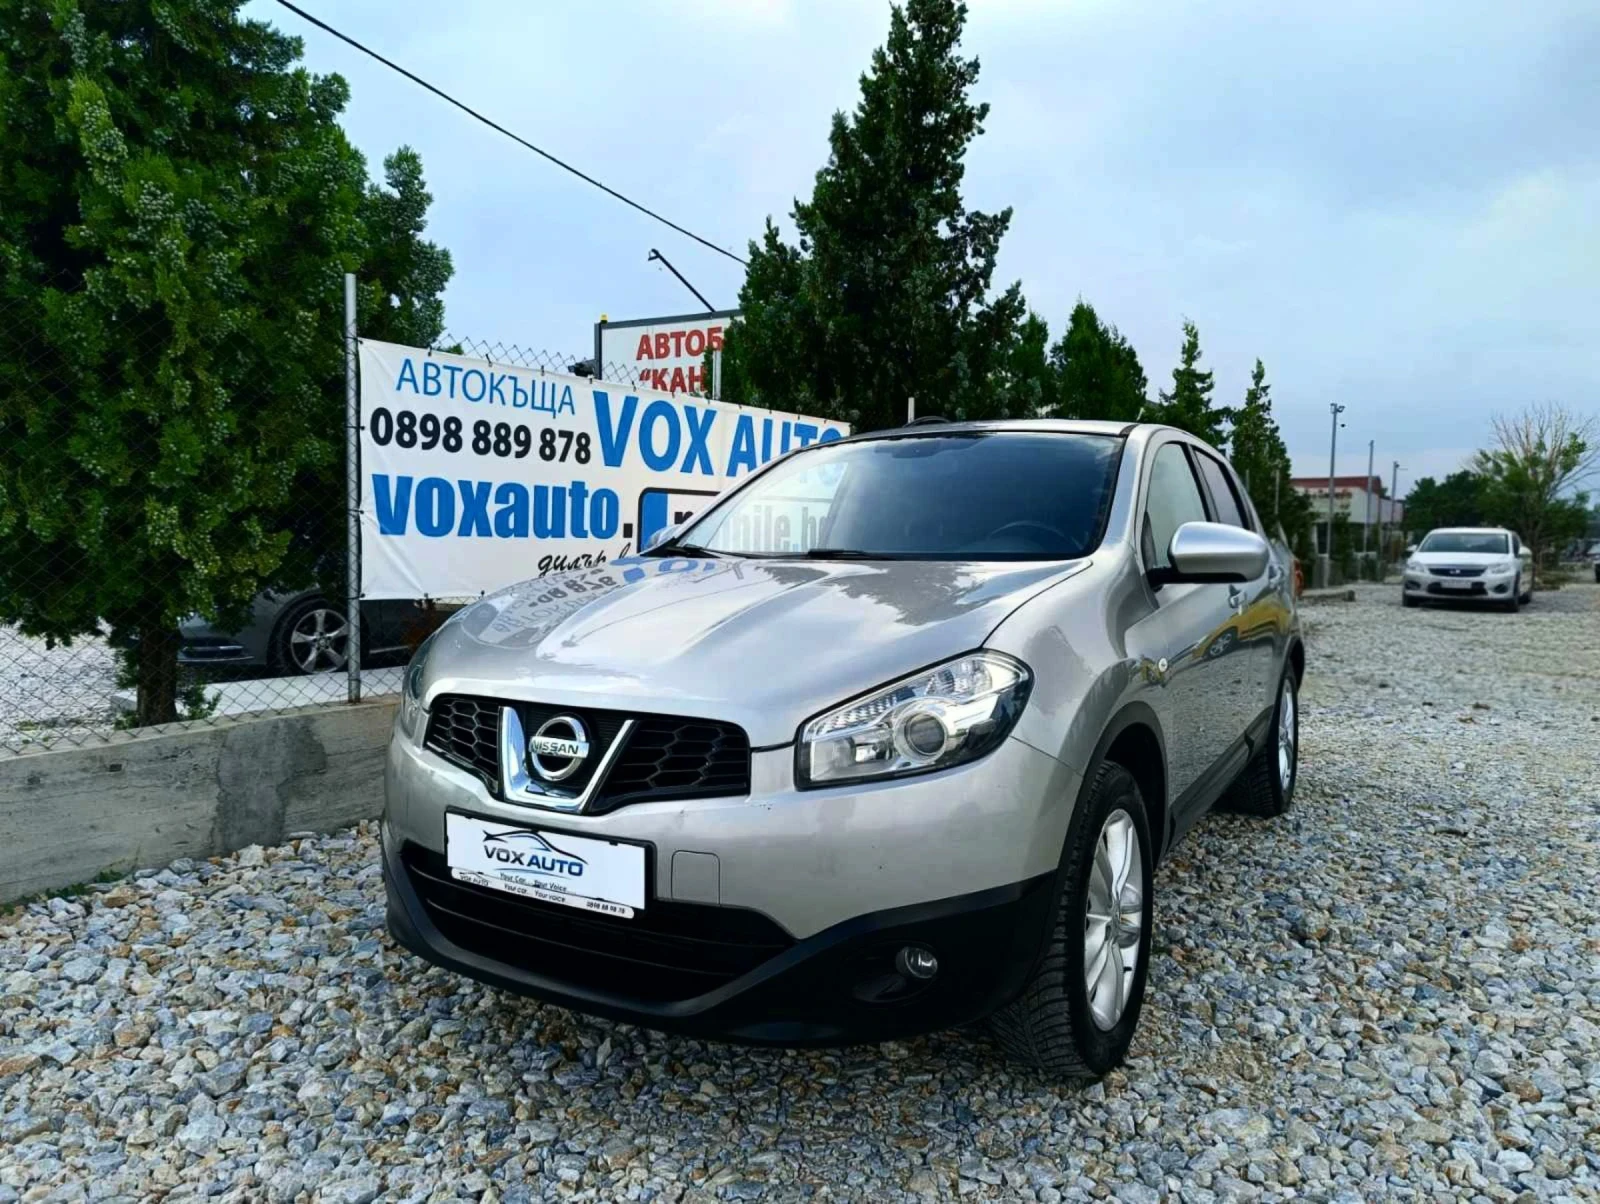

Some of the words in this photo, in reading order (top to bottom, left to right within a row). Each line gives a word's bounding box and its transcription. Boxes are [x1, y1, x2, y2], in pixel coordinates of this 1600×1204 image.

[396, 359, 575, 419] АВТОКЪЩА
[370, 407, 463, 453] 0898
[472, 420, 532, 459] 889
[539, 428, 591, 465] 878
[593, 391, 717, 476] VOX
[726, 414, 842, 477] AUT
[531, 740, 579, 755] NISSAN
[484, 845, 525, 866] VOX
[526, 854, 584, 877] AUTO
